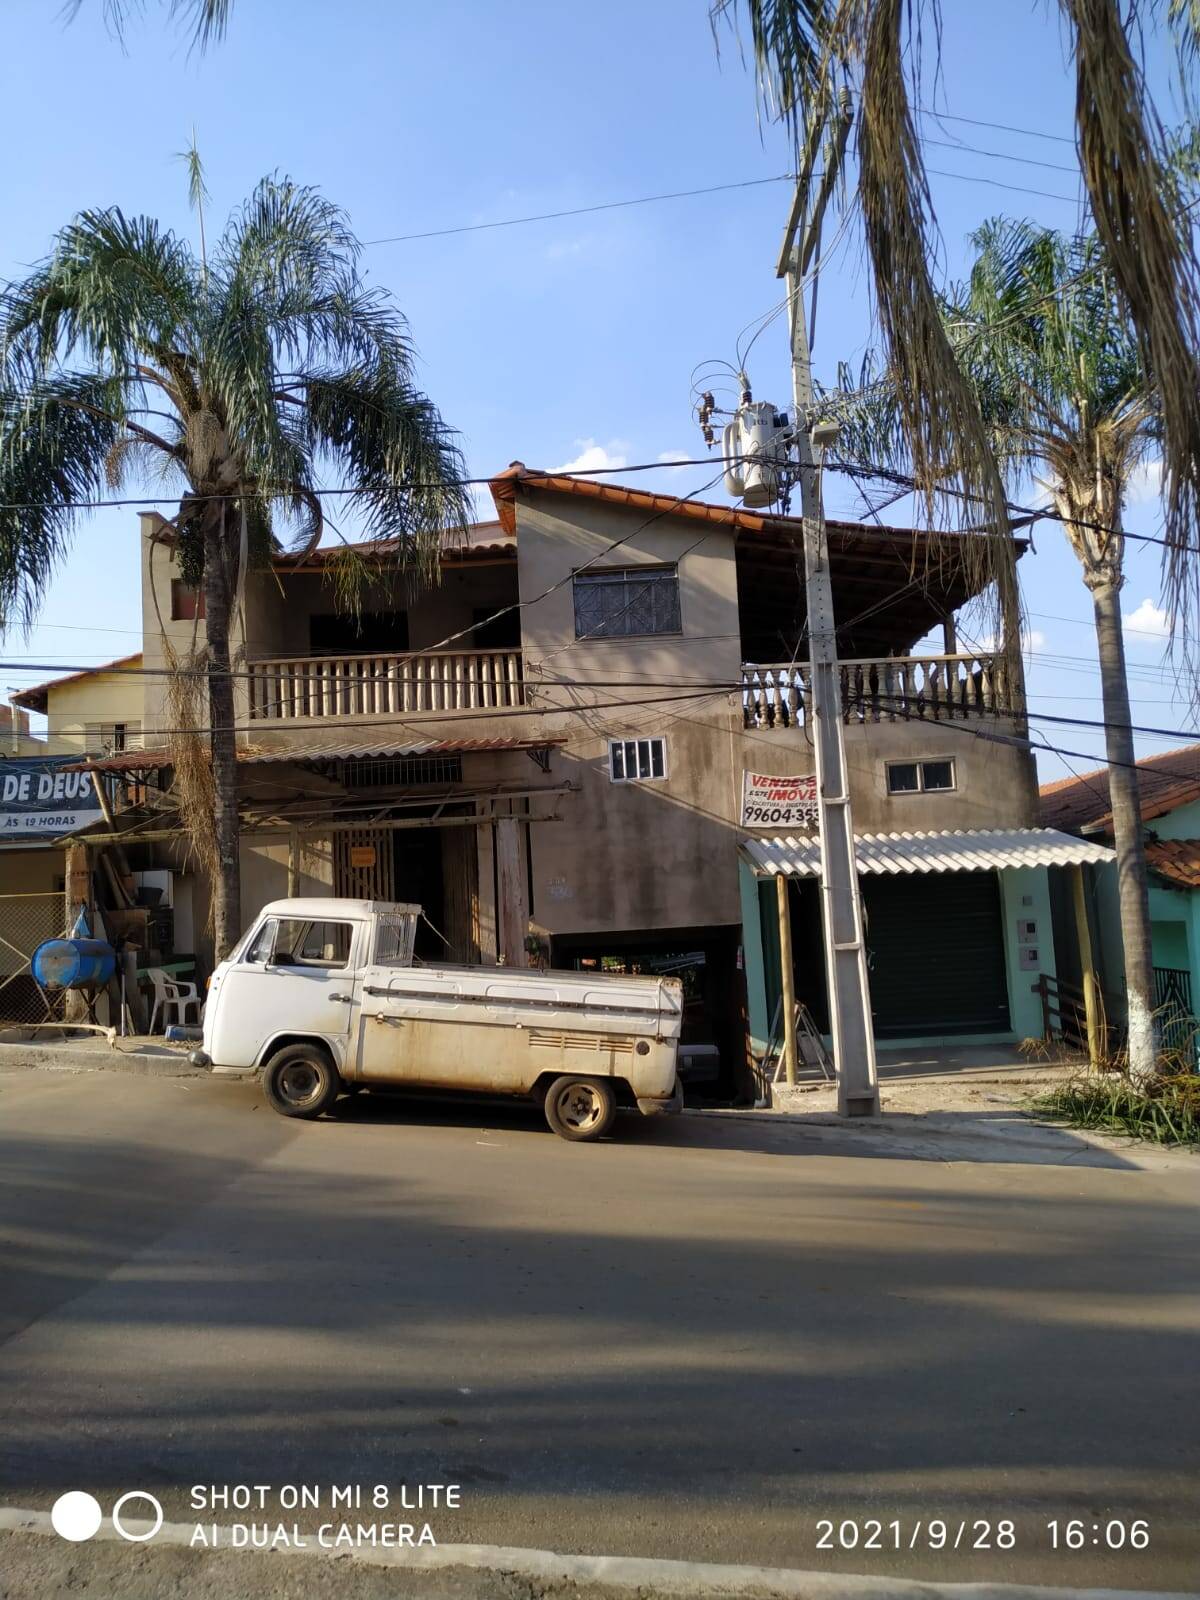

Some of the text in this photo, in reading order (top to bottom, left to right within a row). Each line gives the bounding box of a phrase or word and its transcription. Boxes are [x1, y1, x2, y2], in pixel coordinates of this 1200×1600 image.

[3, 772, 91, 801] DE DEUS
[26, 818, 36, 826] 19
[38, 815, 76, 826] HORAS
